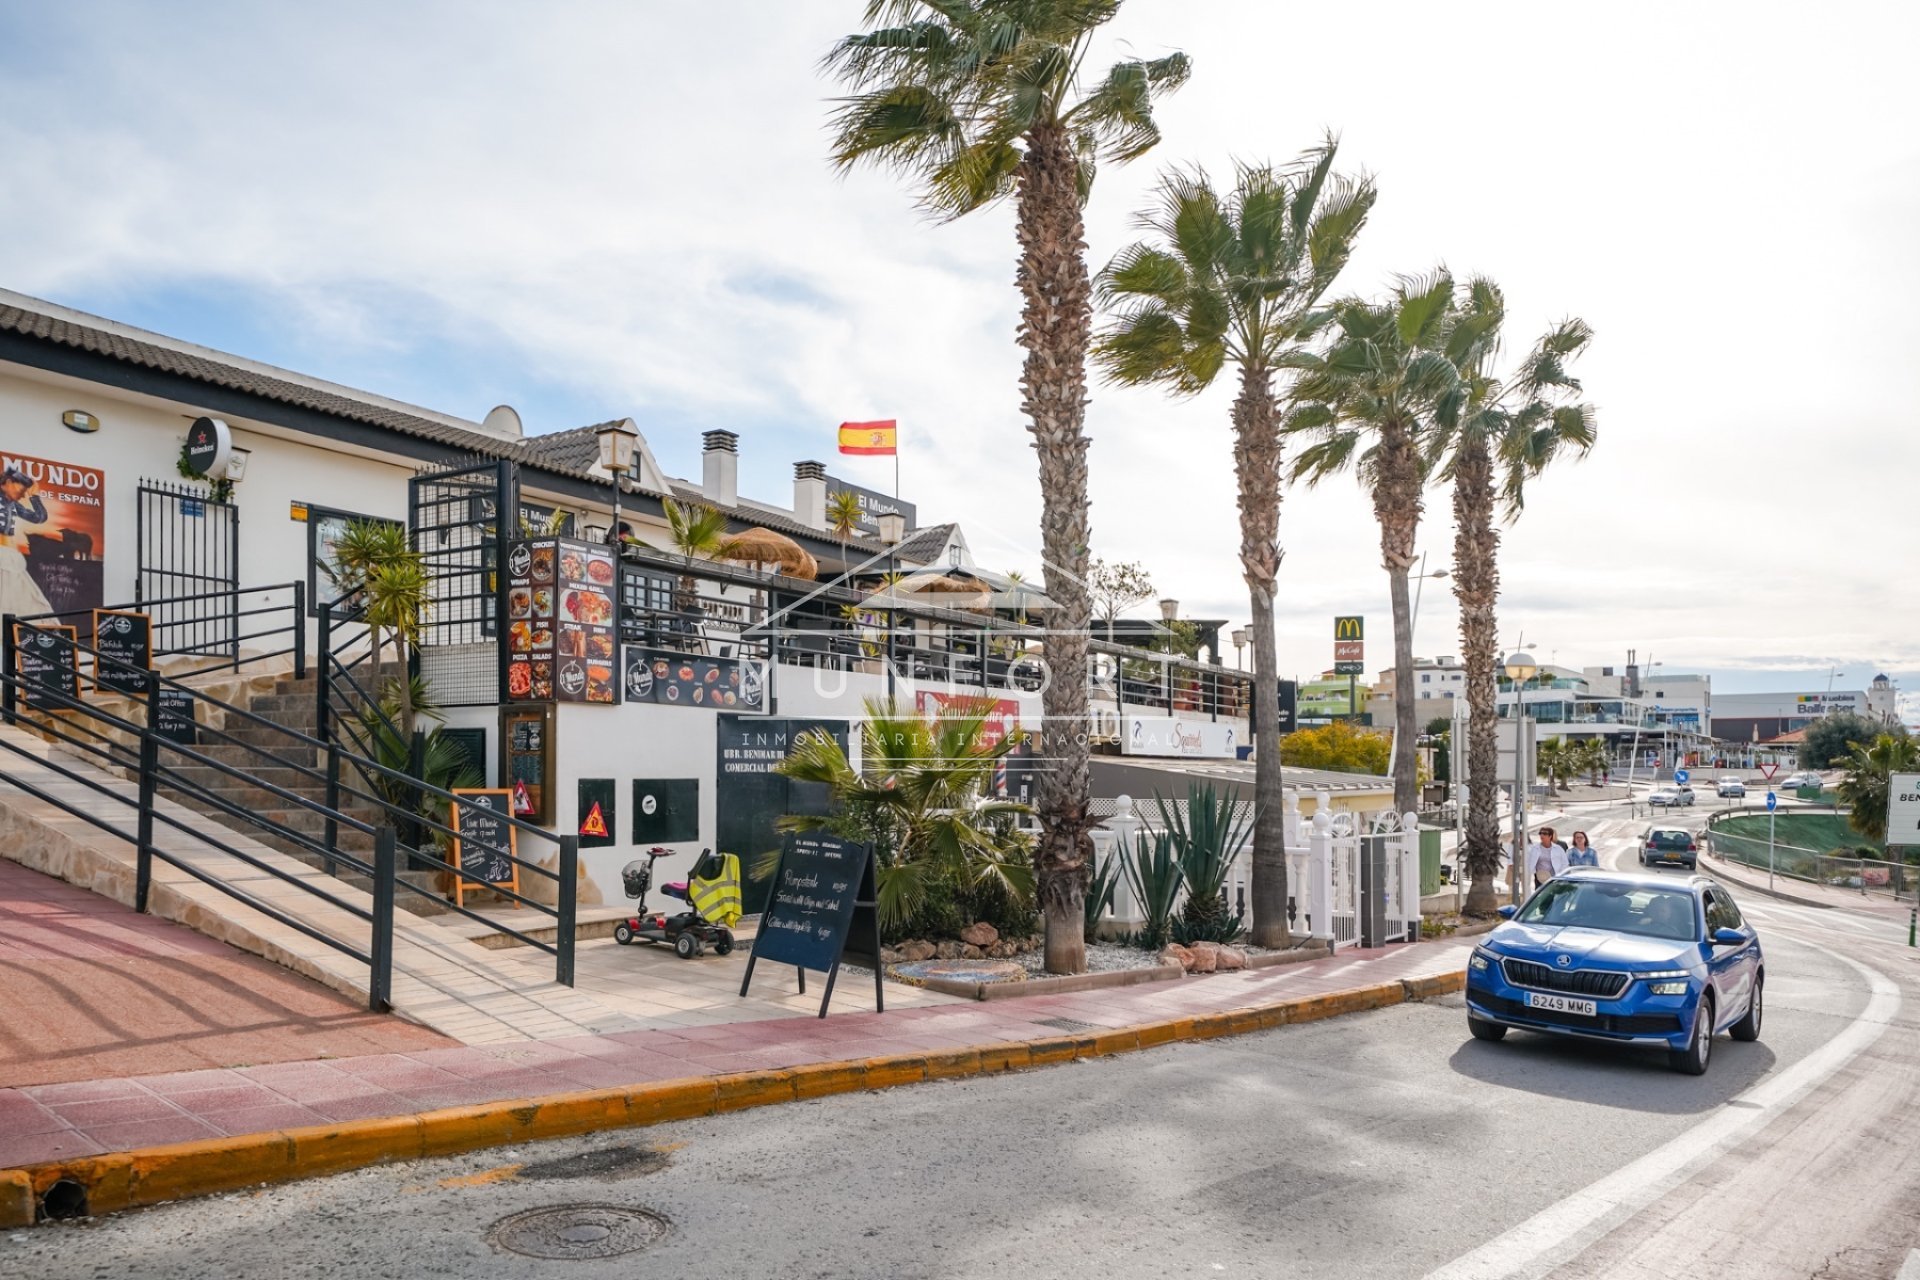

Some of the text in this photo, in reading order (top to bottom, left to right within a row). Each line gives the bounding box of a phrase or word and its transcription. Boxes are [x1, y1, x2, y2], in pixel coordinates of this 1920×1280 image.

[190, 444, 215, 456] Heineken
[1, 455, 99, 491] MUNDO
[40, 490, 101, 507] DE ESPAÑA
[858, 494, 867, 508] El
[564, 623, 582, 631] STEAK
[743, 749, 775, 759] BENIMAR
[725, 763, 766, 773] COMERCIAL
[1532, 995, 1593, 1014] 6249 MMG
